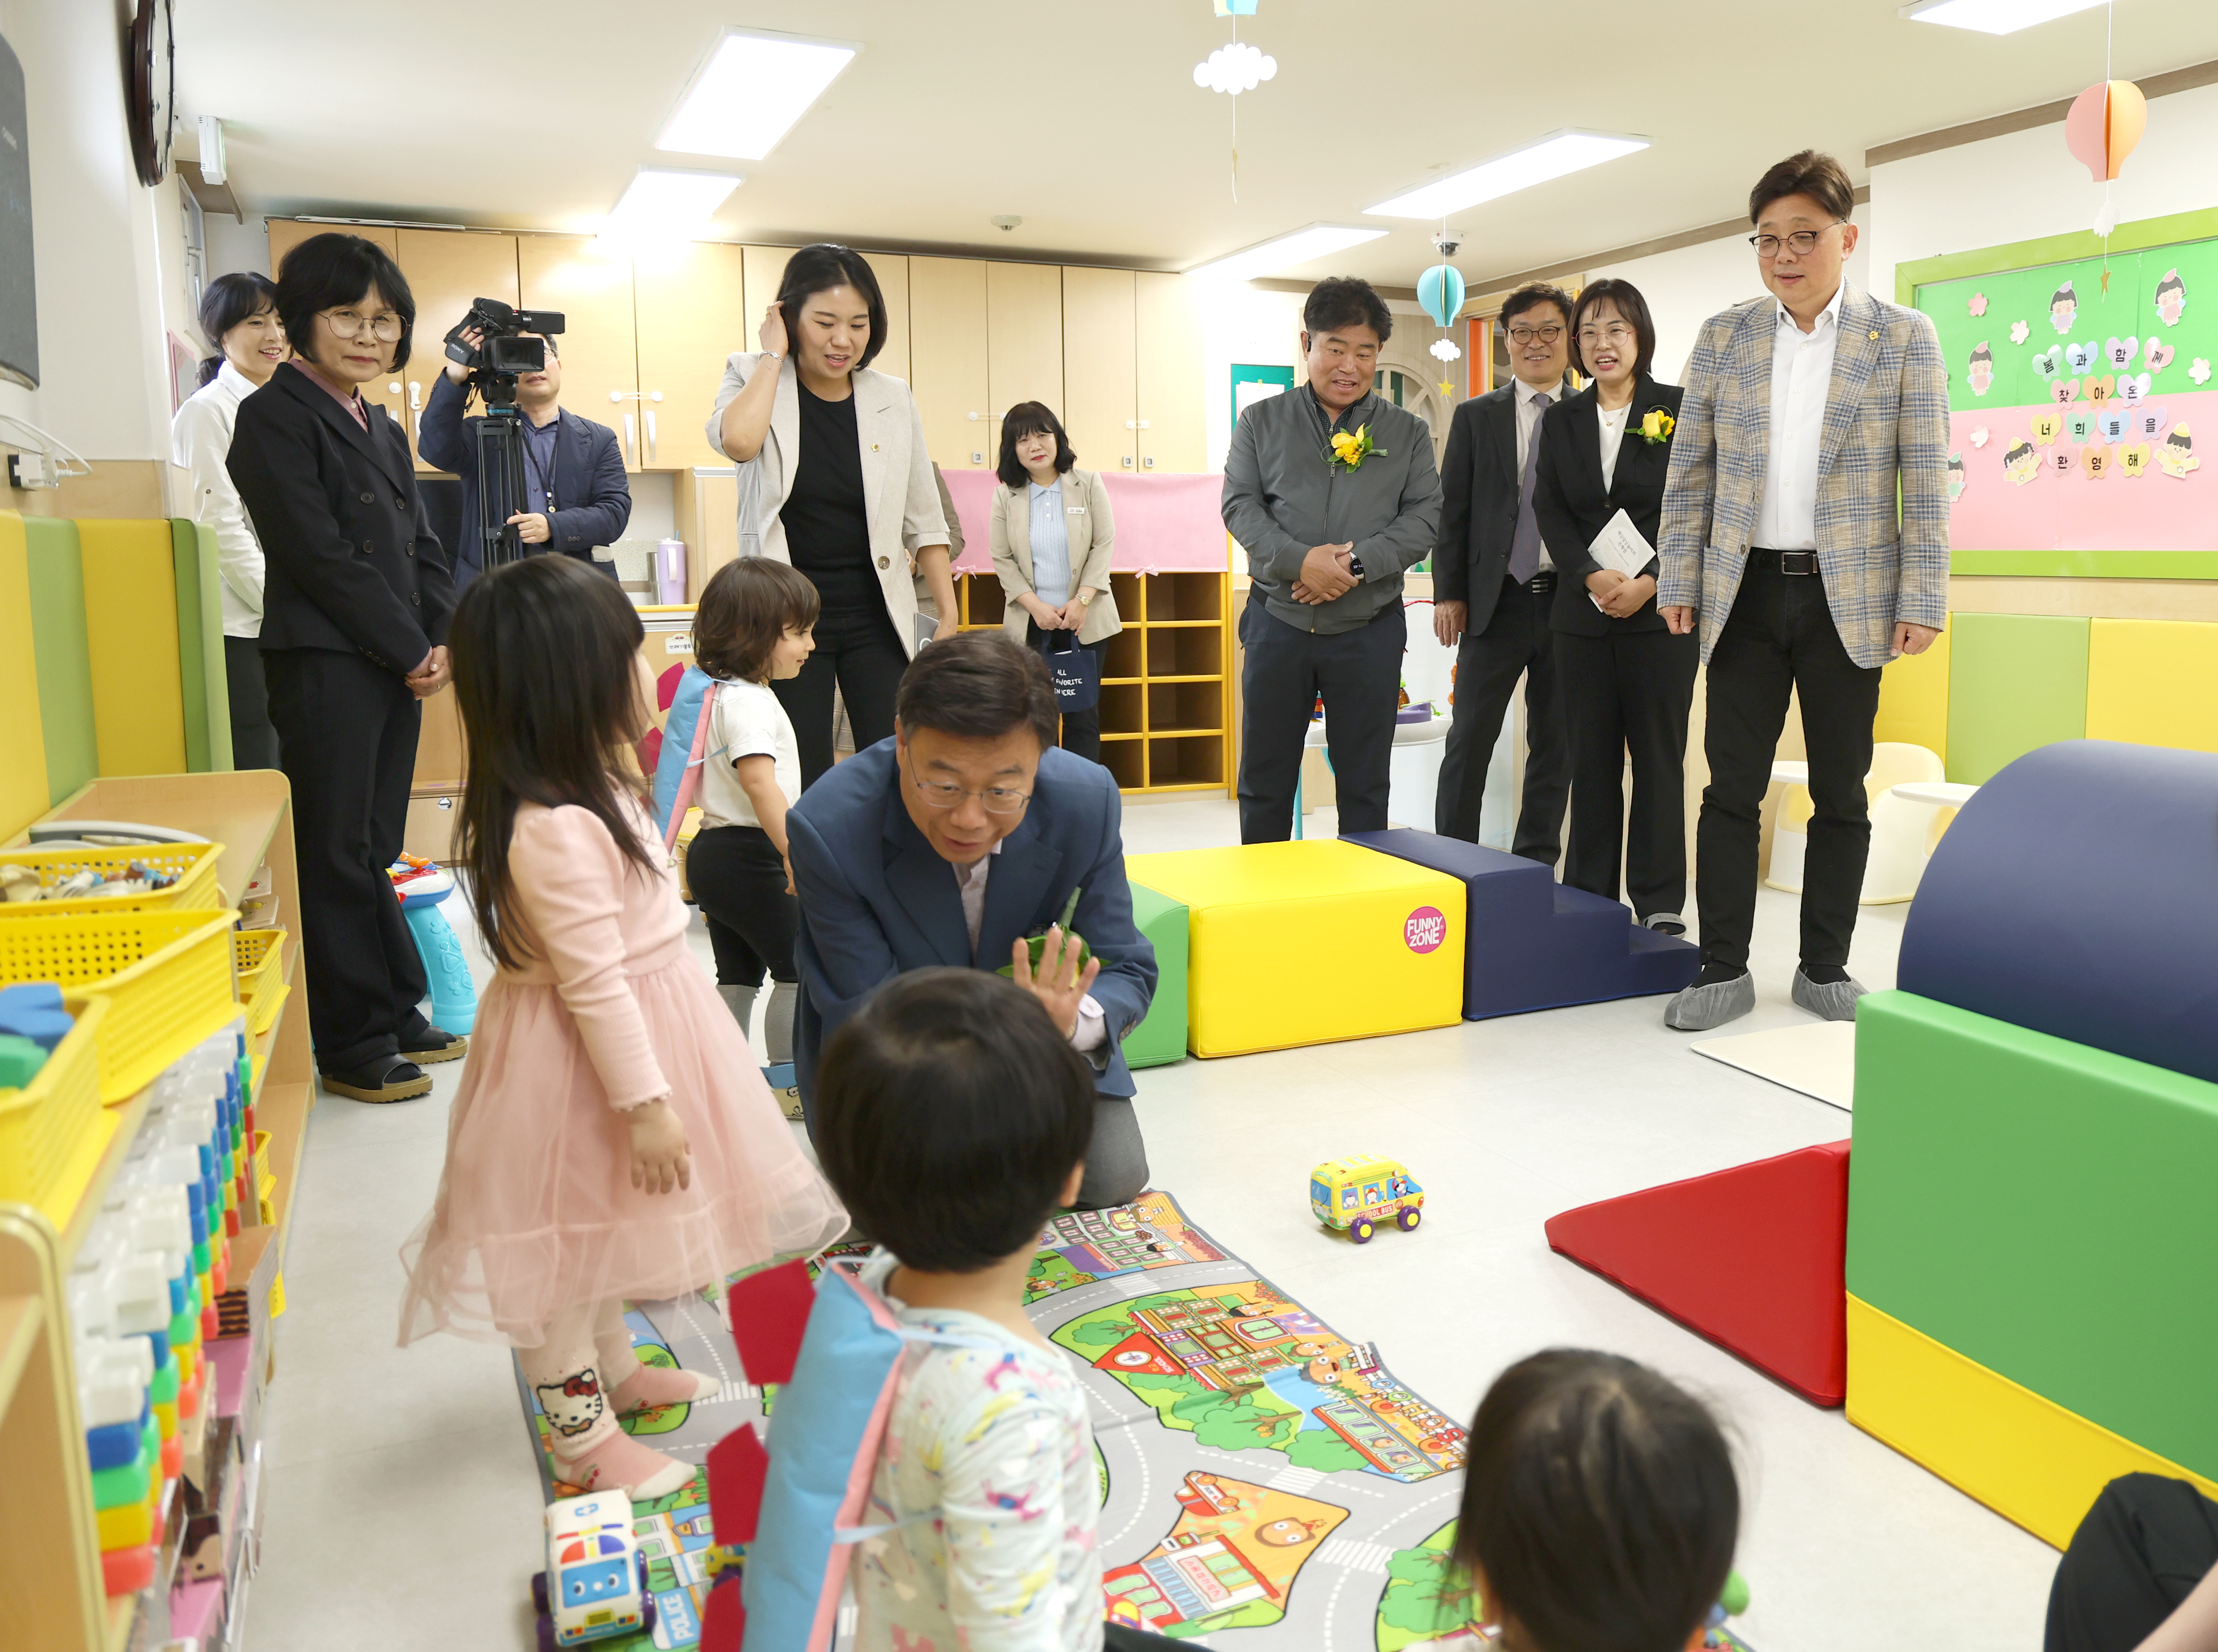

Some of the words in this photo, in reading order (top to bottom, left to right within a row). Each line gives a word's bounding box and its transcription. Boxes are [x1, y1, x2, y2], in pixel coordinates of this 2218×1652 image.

[451, 343, 464, 354] SONY
[2059, 385, 2138, 403] 찾아온
[2041, 418, 2156, 436] 너희들을
[2057, 453, 2138, 470] 환영해
[1407, 916, 1443, 937] FUNNY
[1409, 926, 1440, 947] ZONE
[1357, 1209, 1381, 1218] SCHOOL
[1381, 1205, 1393, 1214] BUS
[1358, 1354, 1465, 1443] SCHOOL
[662, 1593, 695, 1641] POLICE
